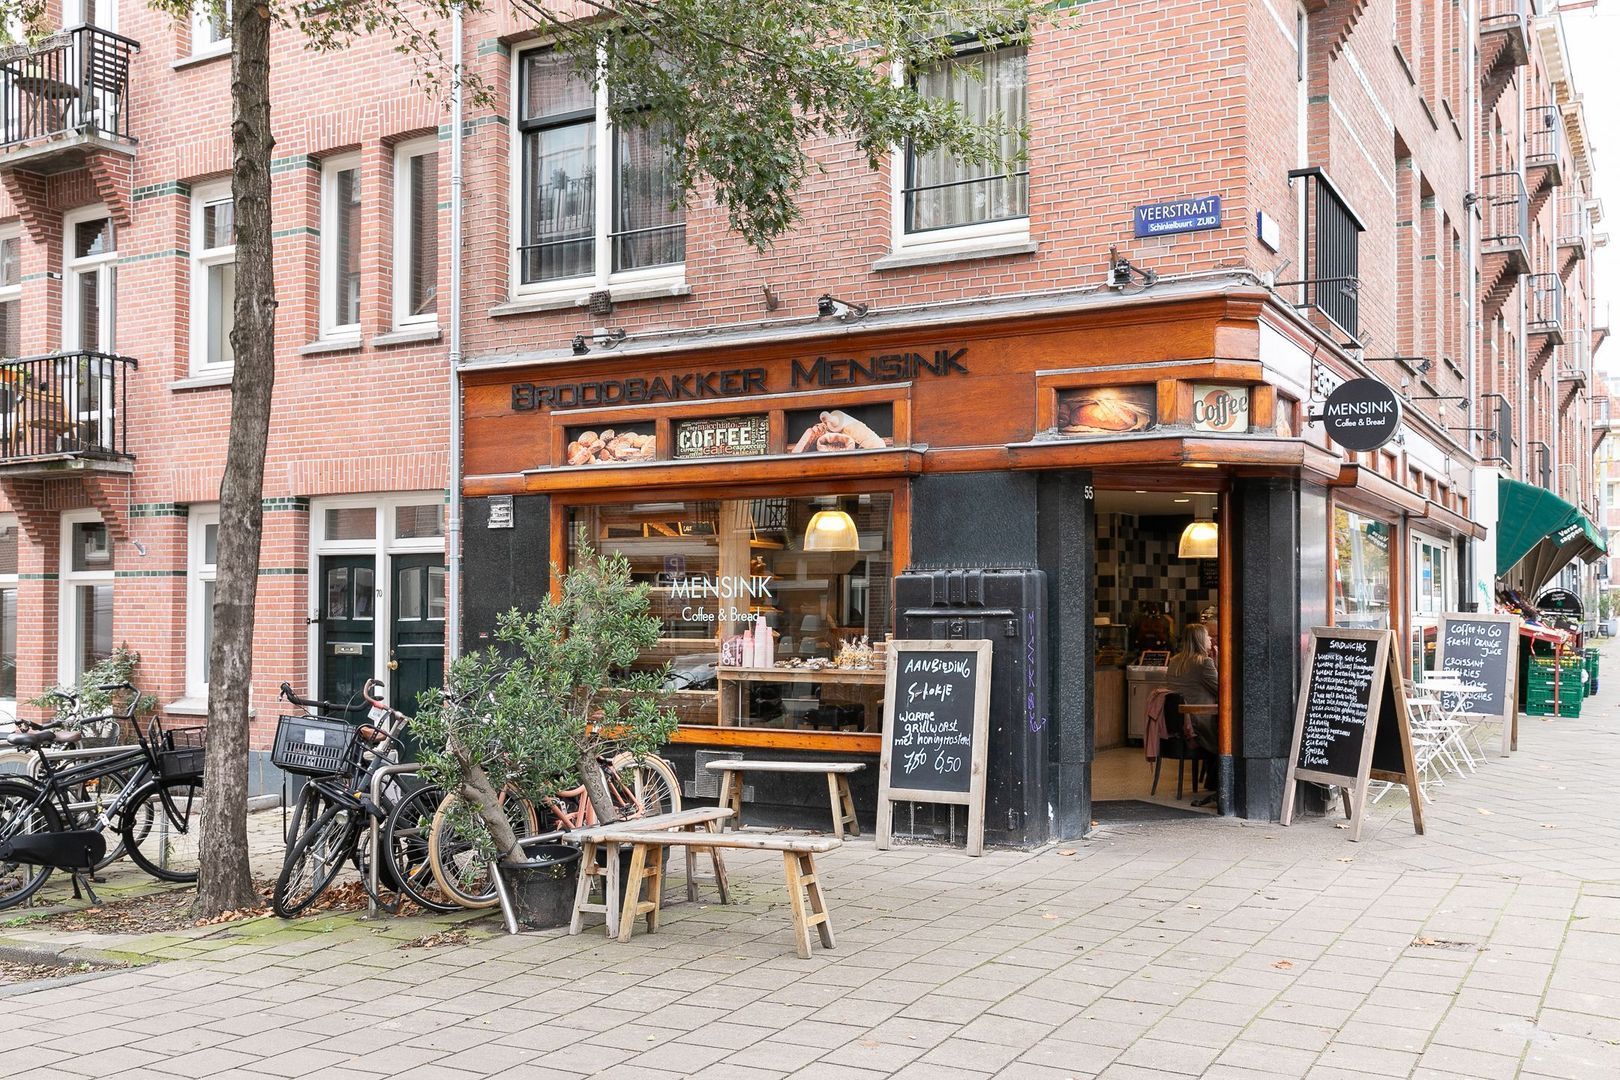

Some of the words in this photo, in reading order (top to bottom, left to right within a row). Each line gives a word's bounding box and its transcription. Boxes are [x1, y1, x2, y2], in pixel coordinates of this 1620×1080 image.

[1139, 200, 1215, 221] VEERSTRAAT
[1149, 219, 1193, 232] Schinkelbuurt
[1196, 216, 1216, 226] ZUID
[511, 368, 767, 410] BROODBAKKER
[791, 348, 969, 387] MENSINK
[1194, 394, 1248, 427] Coffee
[1328, 400, 1393, 416] MENSINK
[1335, 418, 1357, 427] Coffee
[1366, 417, 1386, 426] Bread
[680, 427, 752, 449] COFFEE
[703, 443, 733, 455] cafe
[1084, 485, 1093, 499] 55
[1558, 523, 1578, 537] Verse
[1560, 527, 1584, 544] sappen
[376, 589, 383, 598] 70
[670, 575, 773, 599] MENSINK
[682, 606, 715, 622] Coffee
[718, 609, 728, 622] &
[730, 606, 760, 622] Bread
[1477, 625, 1485, 634] to
[1487, 624, 1502, 637] Go
[1443, 699, 1474, 710] BRAD
[894, 734, 914, 746] met
[934, 750, 962, 774] 6,50
